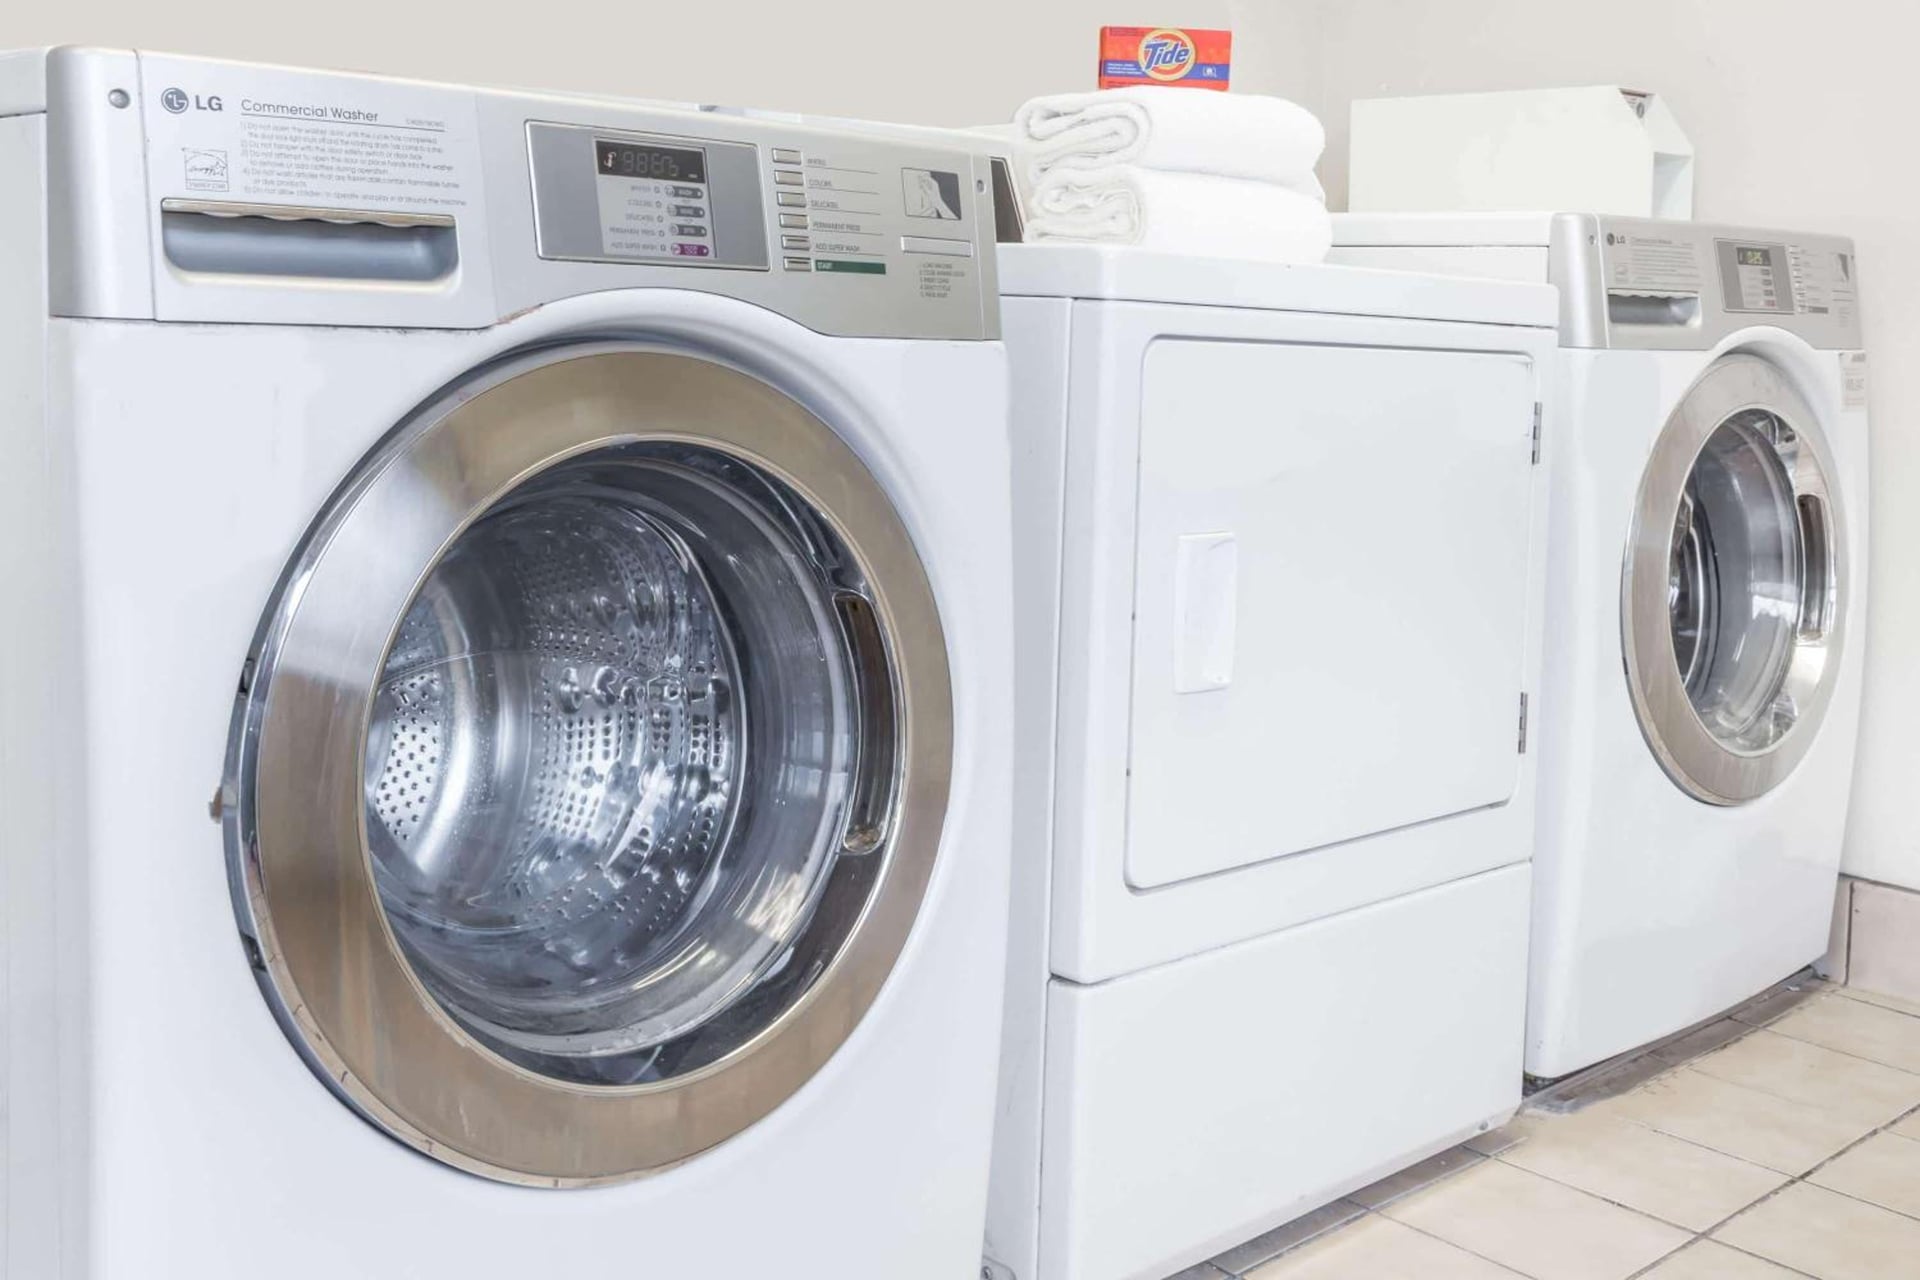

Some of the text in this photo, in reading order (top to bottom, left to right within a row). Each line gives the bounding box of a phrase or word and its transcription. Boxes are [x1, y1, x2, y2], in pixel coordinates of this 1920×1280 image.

[1144, 41, 1190, 71] Tide
[195, 95, 223, 111] LG
[241, 99, 378, 122] Commercial Washer
